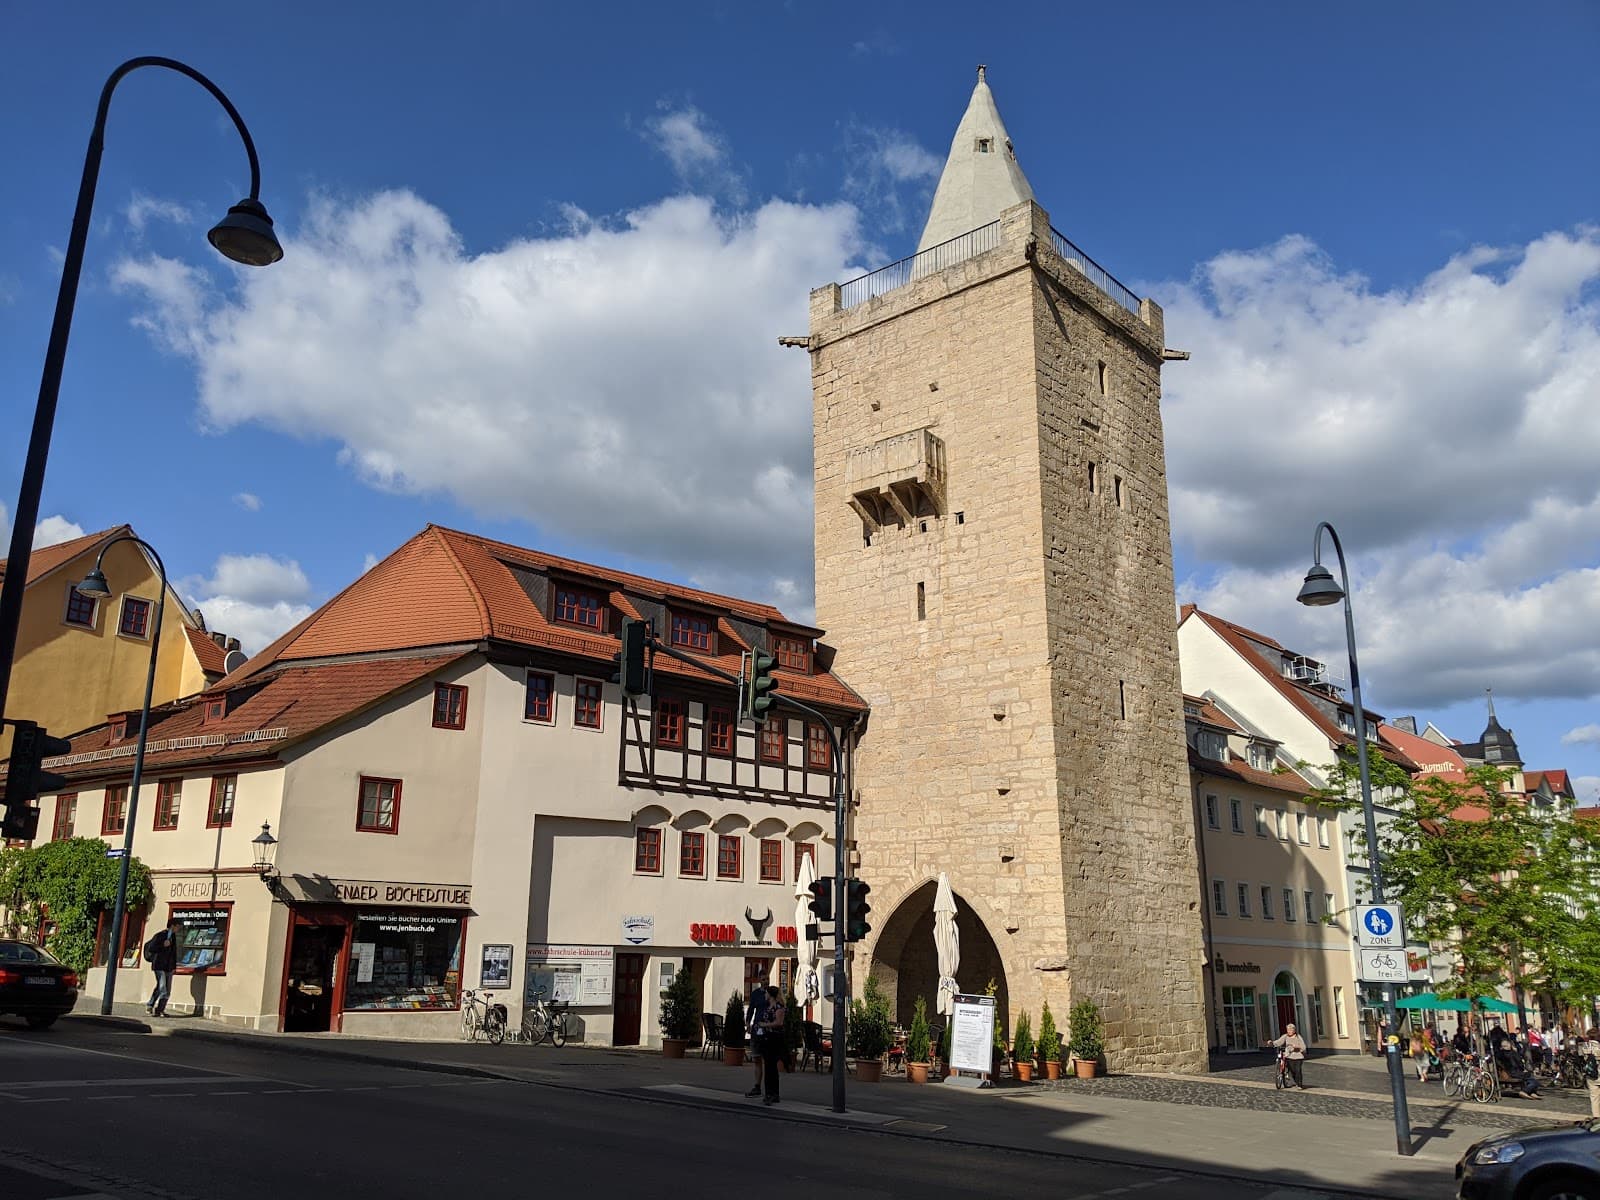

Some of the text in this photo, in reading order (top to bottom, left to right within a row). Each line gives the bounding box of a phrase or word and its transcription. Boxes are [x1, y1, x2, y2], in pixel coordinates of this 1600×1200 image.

[332, 884, 378, 901] ENAER
[379, 924, 435, 933] www.jenbuch.de
[689, 922, 736, 943] STEAK
[1369, 936, 1393, 945] ZONE
[1226, 961, 1261, 974] Immobilien
[1377, 970, 1393, 978] frei
